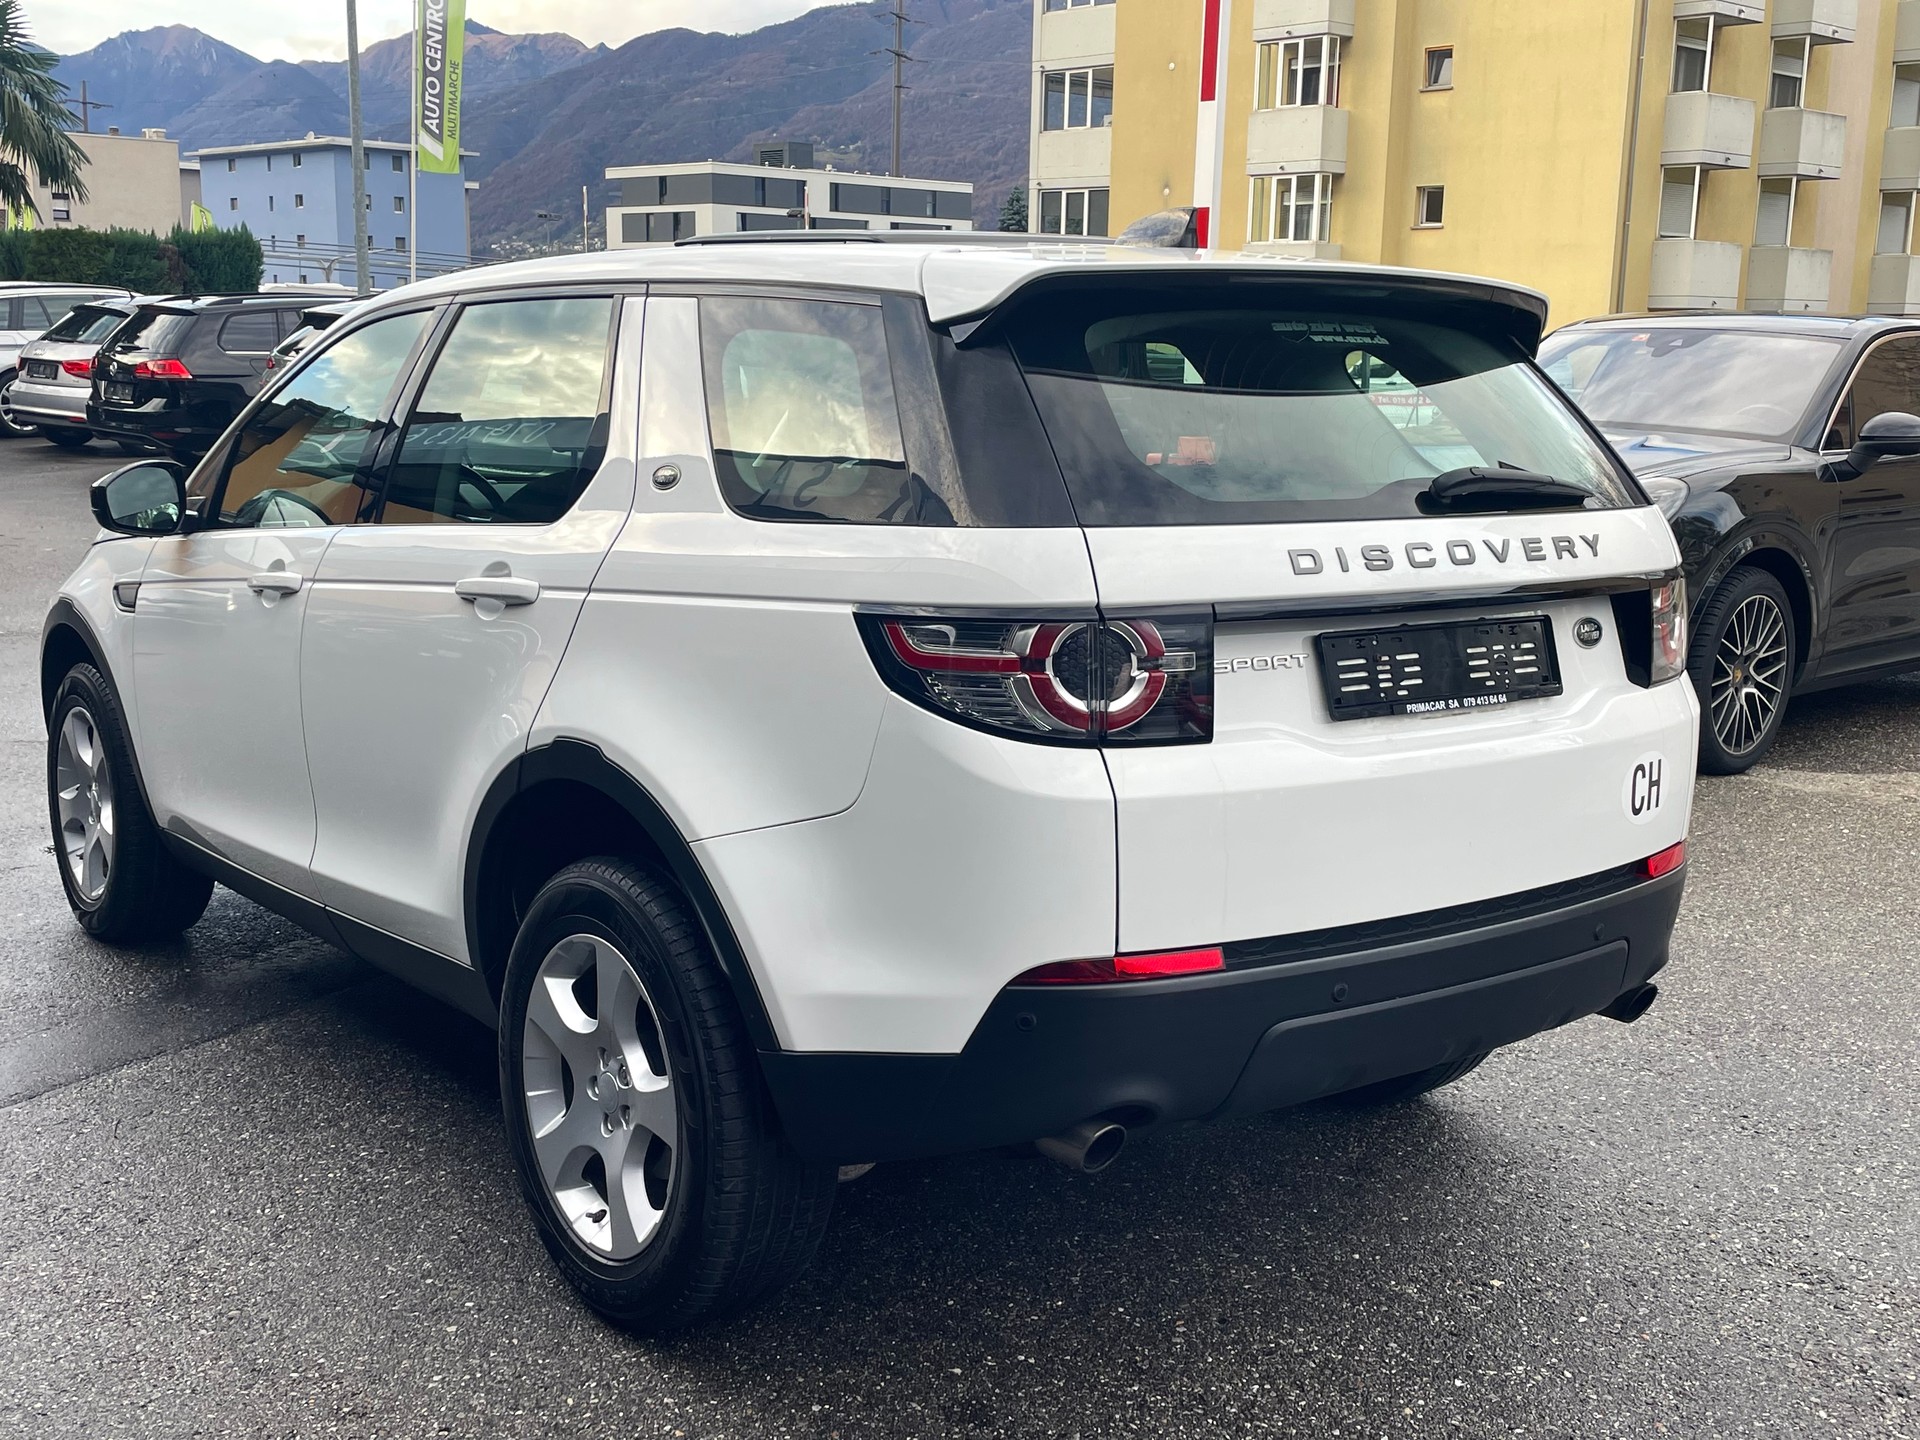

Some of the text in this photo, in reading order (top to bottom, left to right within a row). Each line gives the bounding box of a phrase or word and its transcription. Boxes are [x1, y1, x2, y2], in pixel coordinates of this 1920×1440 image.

[424, 76, 441, 134] AUTO
[447, 60, 460, 139] MULTIMARCHE
[1287, 533, 1600, 576] DISCOVERY
[1214, 653, 1310, 675] SPORT
[1406, 693, 1508, 713] PRIMACAR SA 079 413 64 64
[1631, 758, 1662, 816] CH
